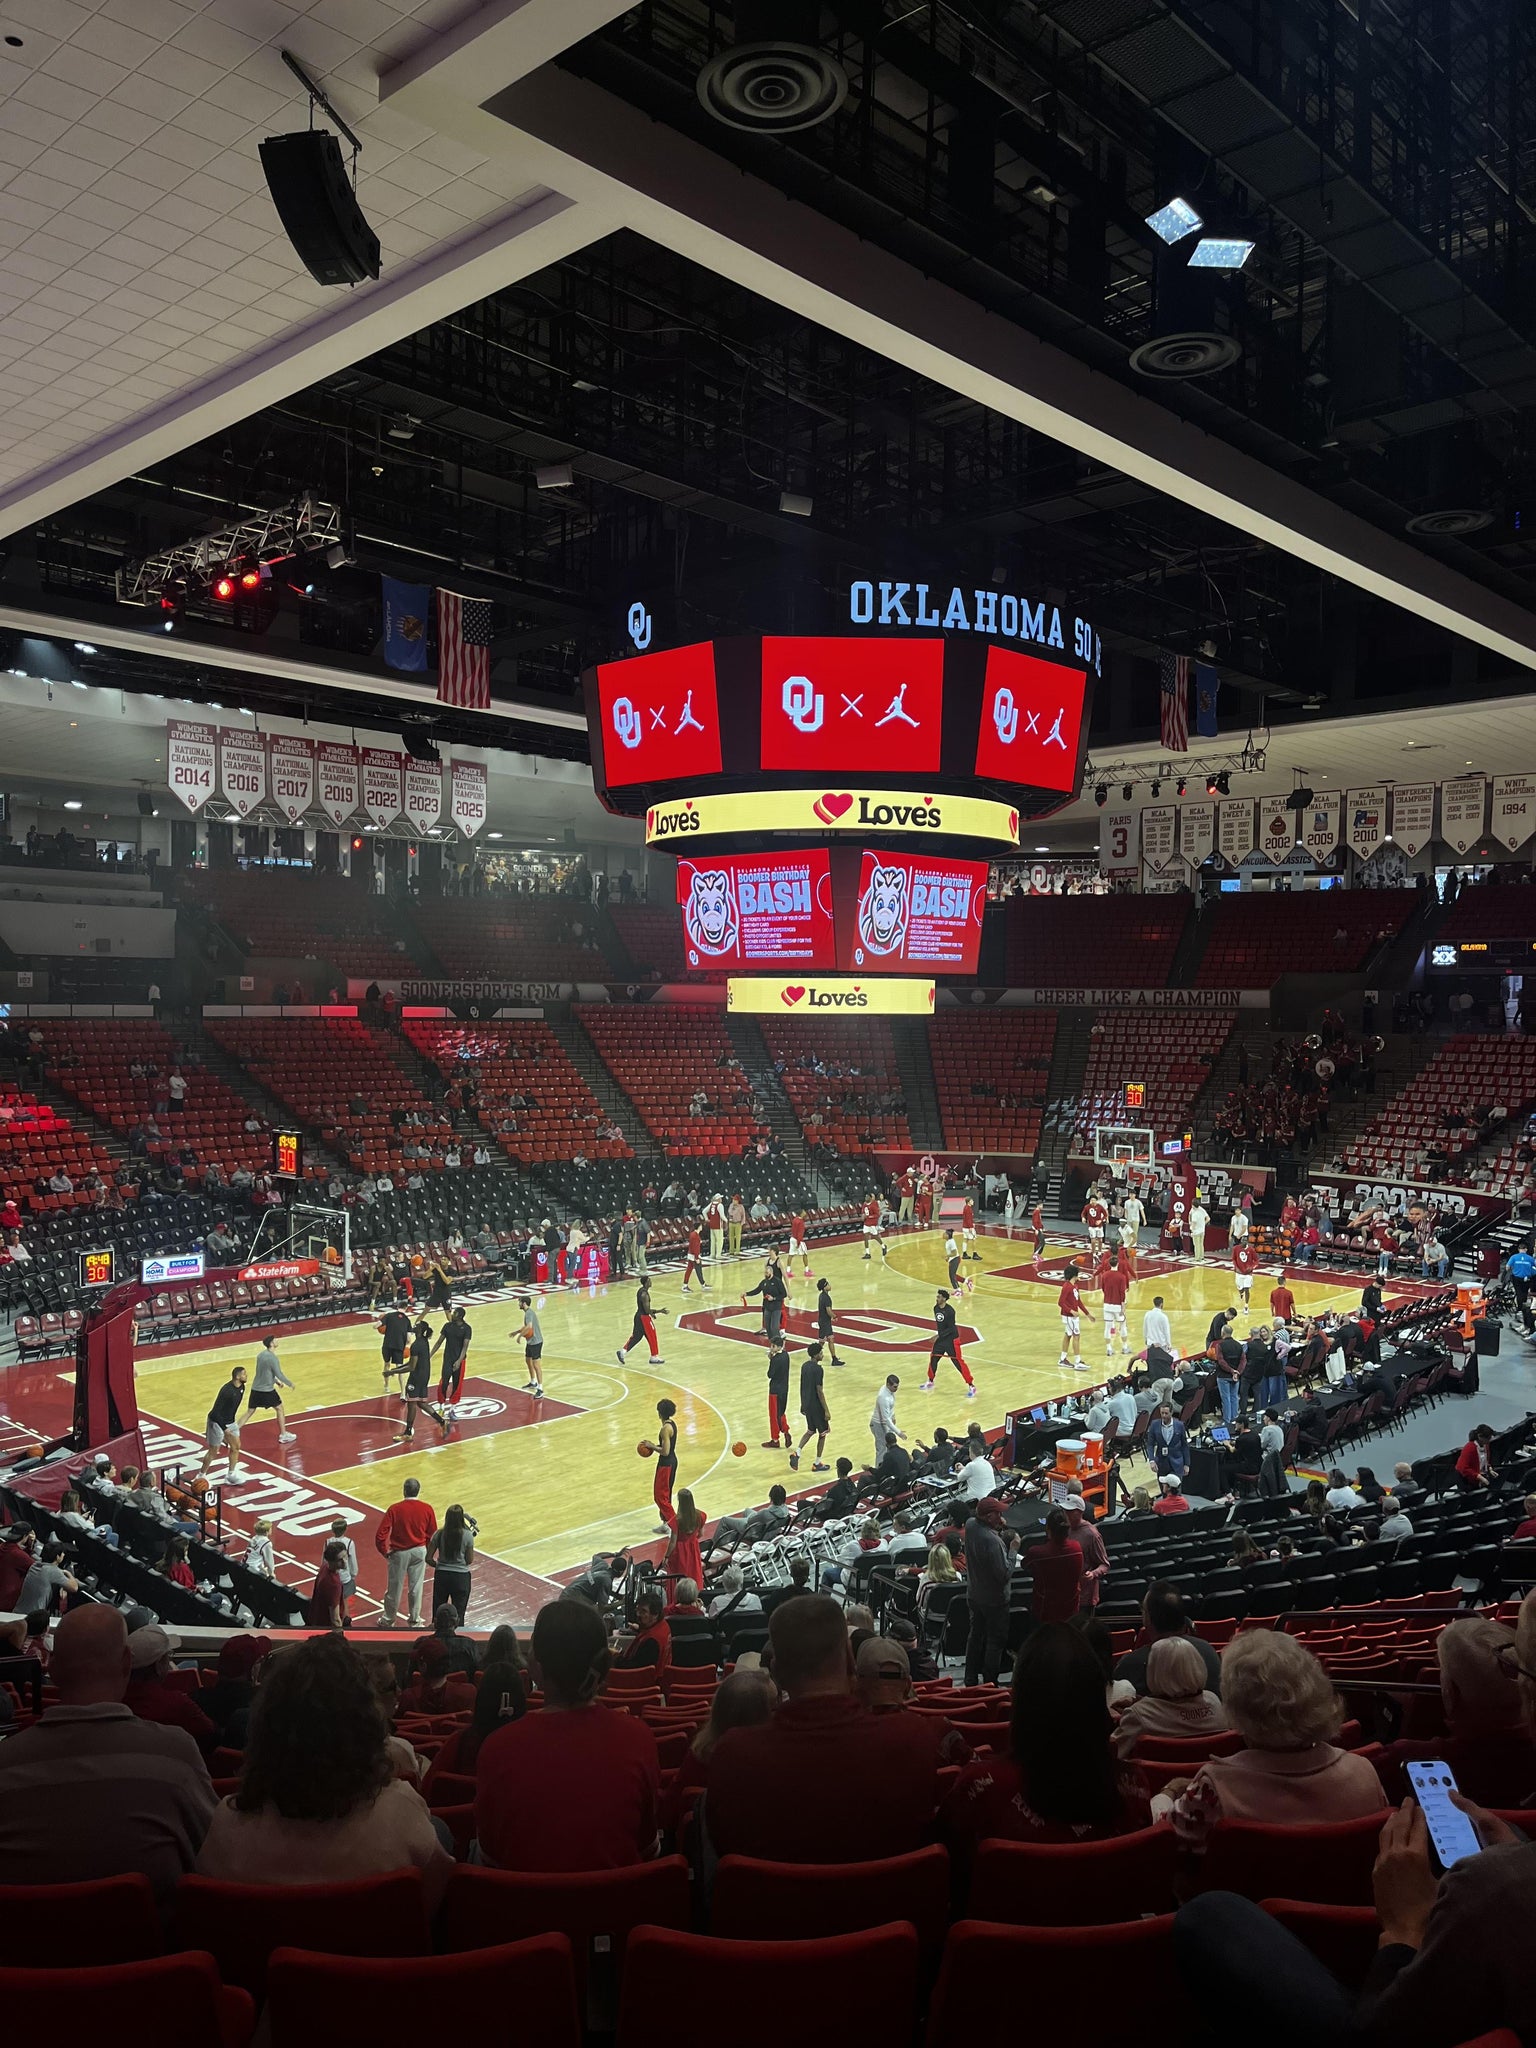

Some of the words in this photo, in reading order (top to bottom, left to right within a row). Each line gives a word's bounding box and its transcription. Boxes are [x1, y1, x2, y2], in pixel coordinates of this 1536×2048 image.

[850, 581, 1065, 649] OKLAHOMA
[628, 602, 651, 649] OU
[782, 676, 824, 732] OU
[993, 687, 1018, 744] OU
[177, 723, 207, 734] WOMEN'S
[612, 697, 642, 748] OU
[171, 730, 213, 743] GYMNASTICS
[229, 731, 258, 741] WOMEN'S
[224, 738, 263, 750] GYMNASTICS
[279, 739, 306, 748] WOMEN'S
[175, 745, 210, 757] NATIONAL
[274, 745, 310, 756] GYMNASTICS
[326, 746, 352, 756] WOMEN'S
[369, 751, 395, 760] WOMEN'S
[172, 754, 213, 766] CHAMPIONS
[227, 752, 260, 763] NATIONAL
[276, 758, 308, 769] NATIONAL
[321, 753, 356, 763] GYMNASTICS
[365, 758, 399, 768] GYMNASTICS
[224, 761, 263, 772] CHAMPIONS
[273, 767, 311, 778] CHAMPIONS
[324, 765, 353, 775] NATIONAL
[407, 763, 440, 774] GYMNASTICS
[175, 767, 209, 786] 2014
[321, 773, 356, 784] CHAMPIONS
[368, 770, 397, 780] NATIONAL
[409, 776, 438, 786] NATIONAL
[228, 774, 258, 792] 2016
[278, 780, 307, 797] 2017
[365, 779, 399, 789] CHAMPIONS
[407, 783, 440, 794] CHAMPIONS
[455, 782, 483, 792] NATIONAL
[1504, 779, 1527, 788] WNIT
[325, 785, 352, 802] 2019
[1395, 787, 1433, 797] CONFERENCE
[1495, 786, 1536, 796] CHAMPIONS
[367, 790, 397, 808] 2022
[409, 795, 438, 813] 2023
[1324, 801, 1339, 809] FOUR
[1396, 795, 1432, 804] CHAMPIONS
[456, 800, 483, 818] 2025
[1228, 802, 1245, 810] NCAA
[1262, 806, 1279, 814] FINAL
[1502, 803, 1526, 815] 1994
[1109, 815, 1132, 826] PARIS
[1222, 810, 1244, 819] SWEET
[1307, 833, 1334, 845] 2009
[1353, 829, 1378, 843] 2010
[1112, 827, 1128, 858] 3
[1265, 837, 1291, 849] 2002
[1284, 856, 1312, 865] LASSICS
[513, 864, 548, 872] SOONERS
[737, 872, 770, 883] BOOMER
[771, 869, 810, 881] BIRTHDAY
[914, 874, 941, 885] BOOMER
[942, 877, 972, 889] BIRTHDAY
[1031, 865, 1052, 893] OU
[738, 880, 812, 914] BASH
[911, 885, 971, 919] BASH
[401, 982, 560, 1000] SOONERSPORTS.COM
[1034, 990, 1086, 1005] CHEER
[1090, 991, 1131, 1005] LIKE
[1139, 991, 1153, 1006] A
[1153, 990, 1241, 1006] CHAMPION
[1127, 1084, 1144, 1092] 19:48
[1127, 1093, 1142, 1106] 30
[278, 1136, 296, 1149] 19:48
[279, 1150, 296, 1173] 30
[1174, 1183, 1184, 1197] OU
[86, 1254, 110, 1267] 19:48
[88, 1267, 106, 1280] 30
[168, 1267, 199, 1275] CHAMPIONS
[204, 1490, 217, 1507] OU
